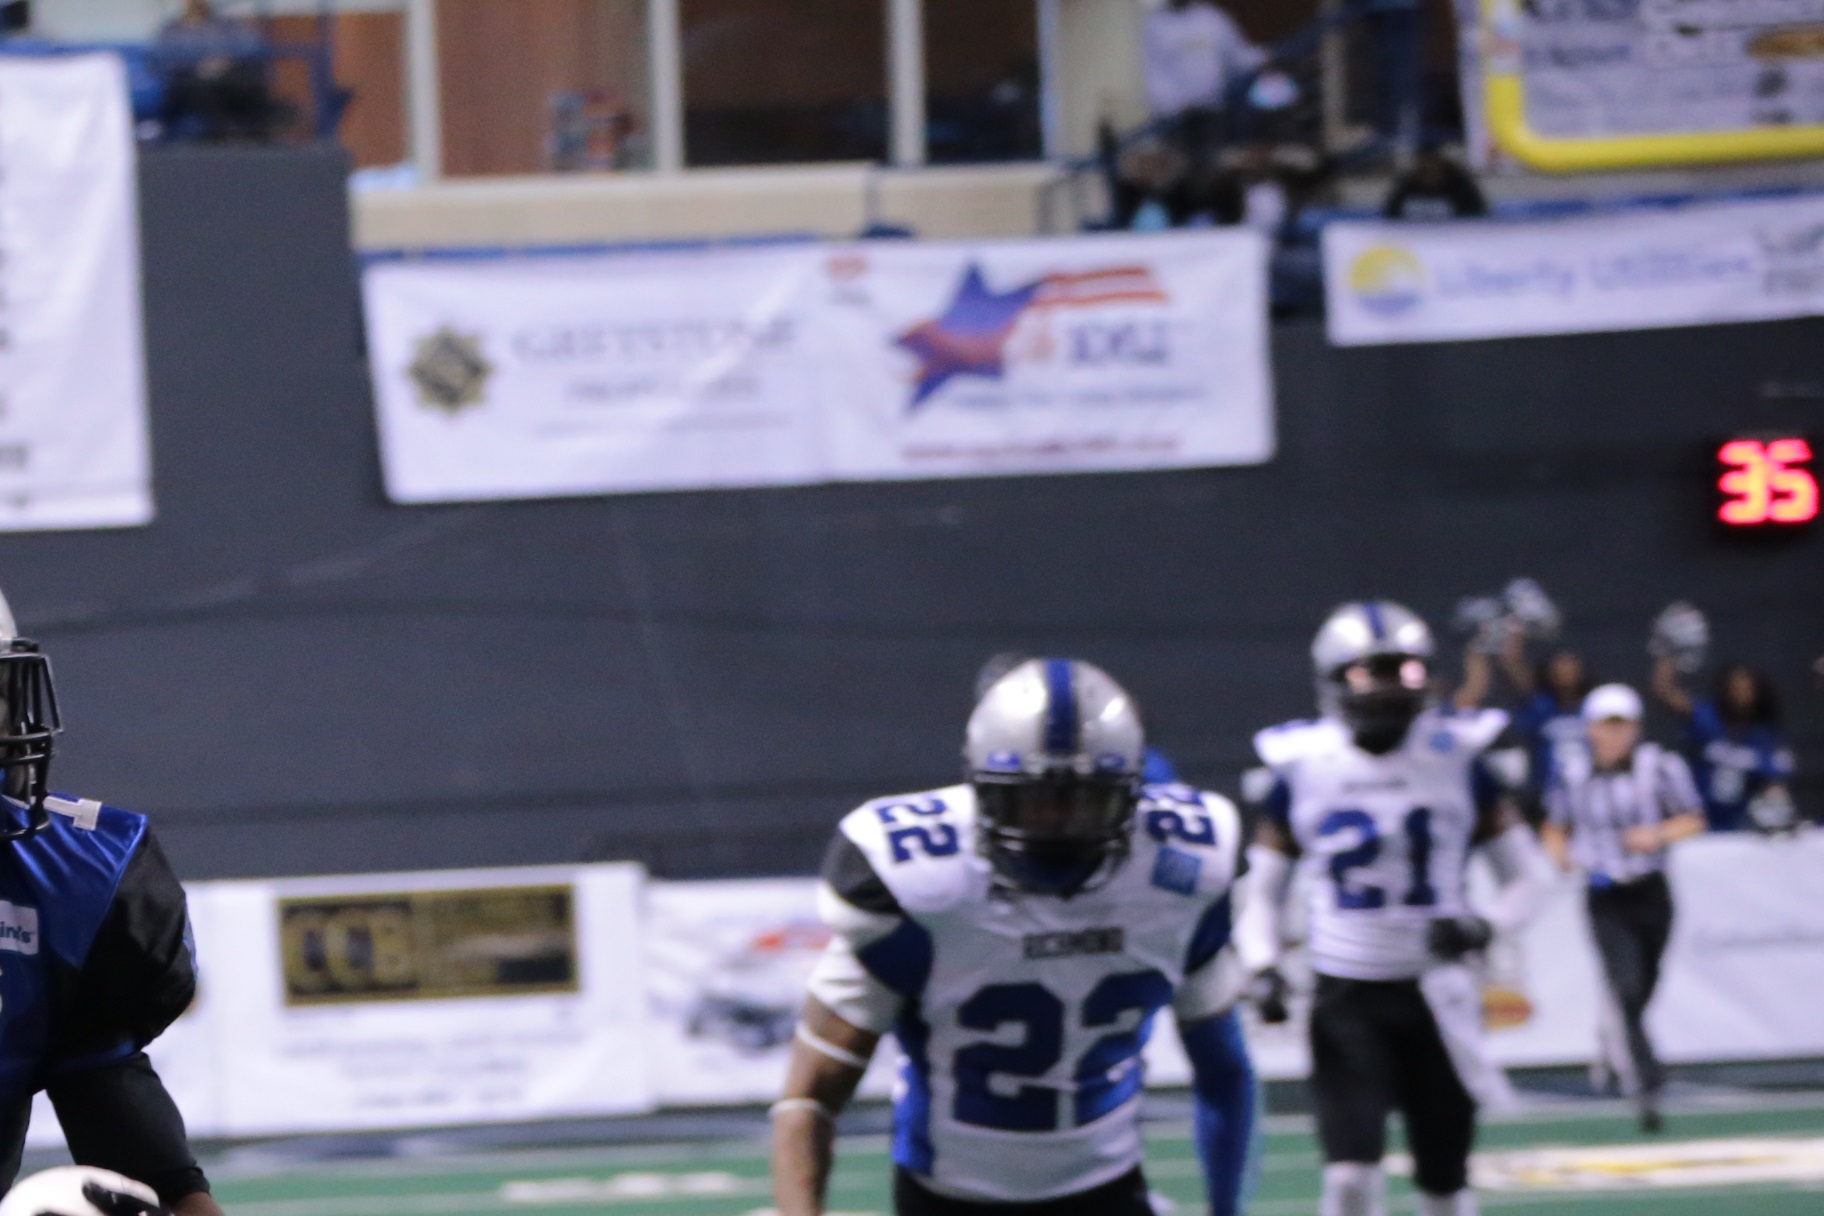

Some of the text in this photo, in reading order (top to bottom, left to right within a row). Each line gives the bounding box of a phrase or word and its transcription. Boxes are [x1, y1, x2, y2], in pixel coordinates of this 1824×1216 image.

[1717, 437, 1819, 524] 35
[875, 798, 960, 864] 22
[1318, 806, 1436, 910] 21
[952, 969, 1173, 1132] 22
